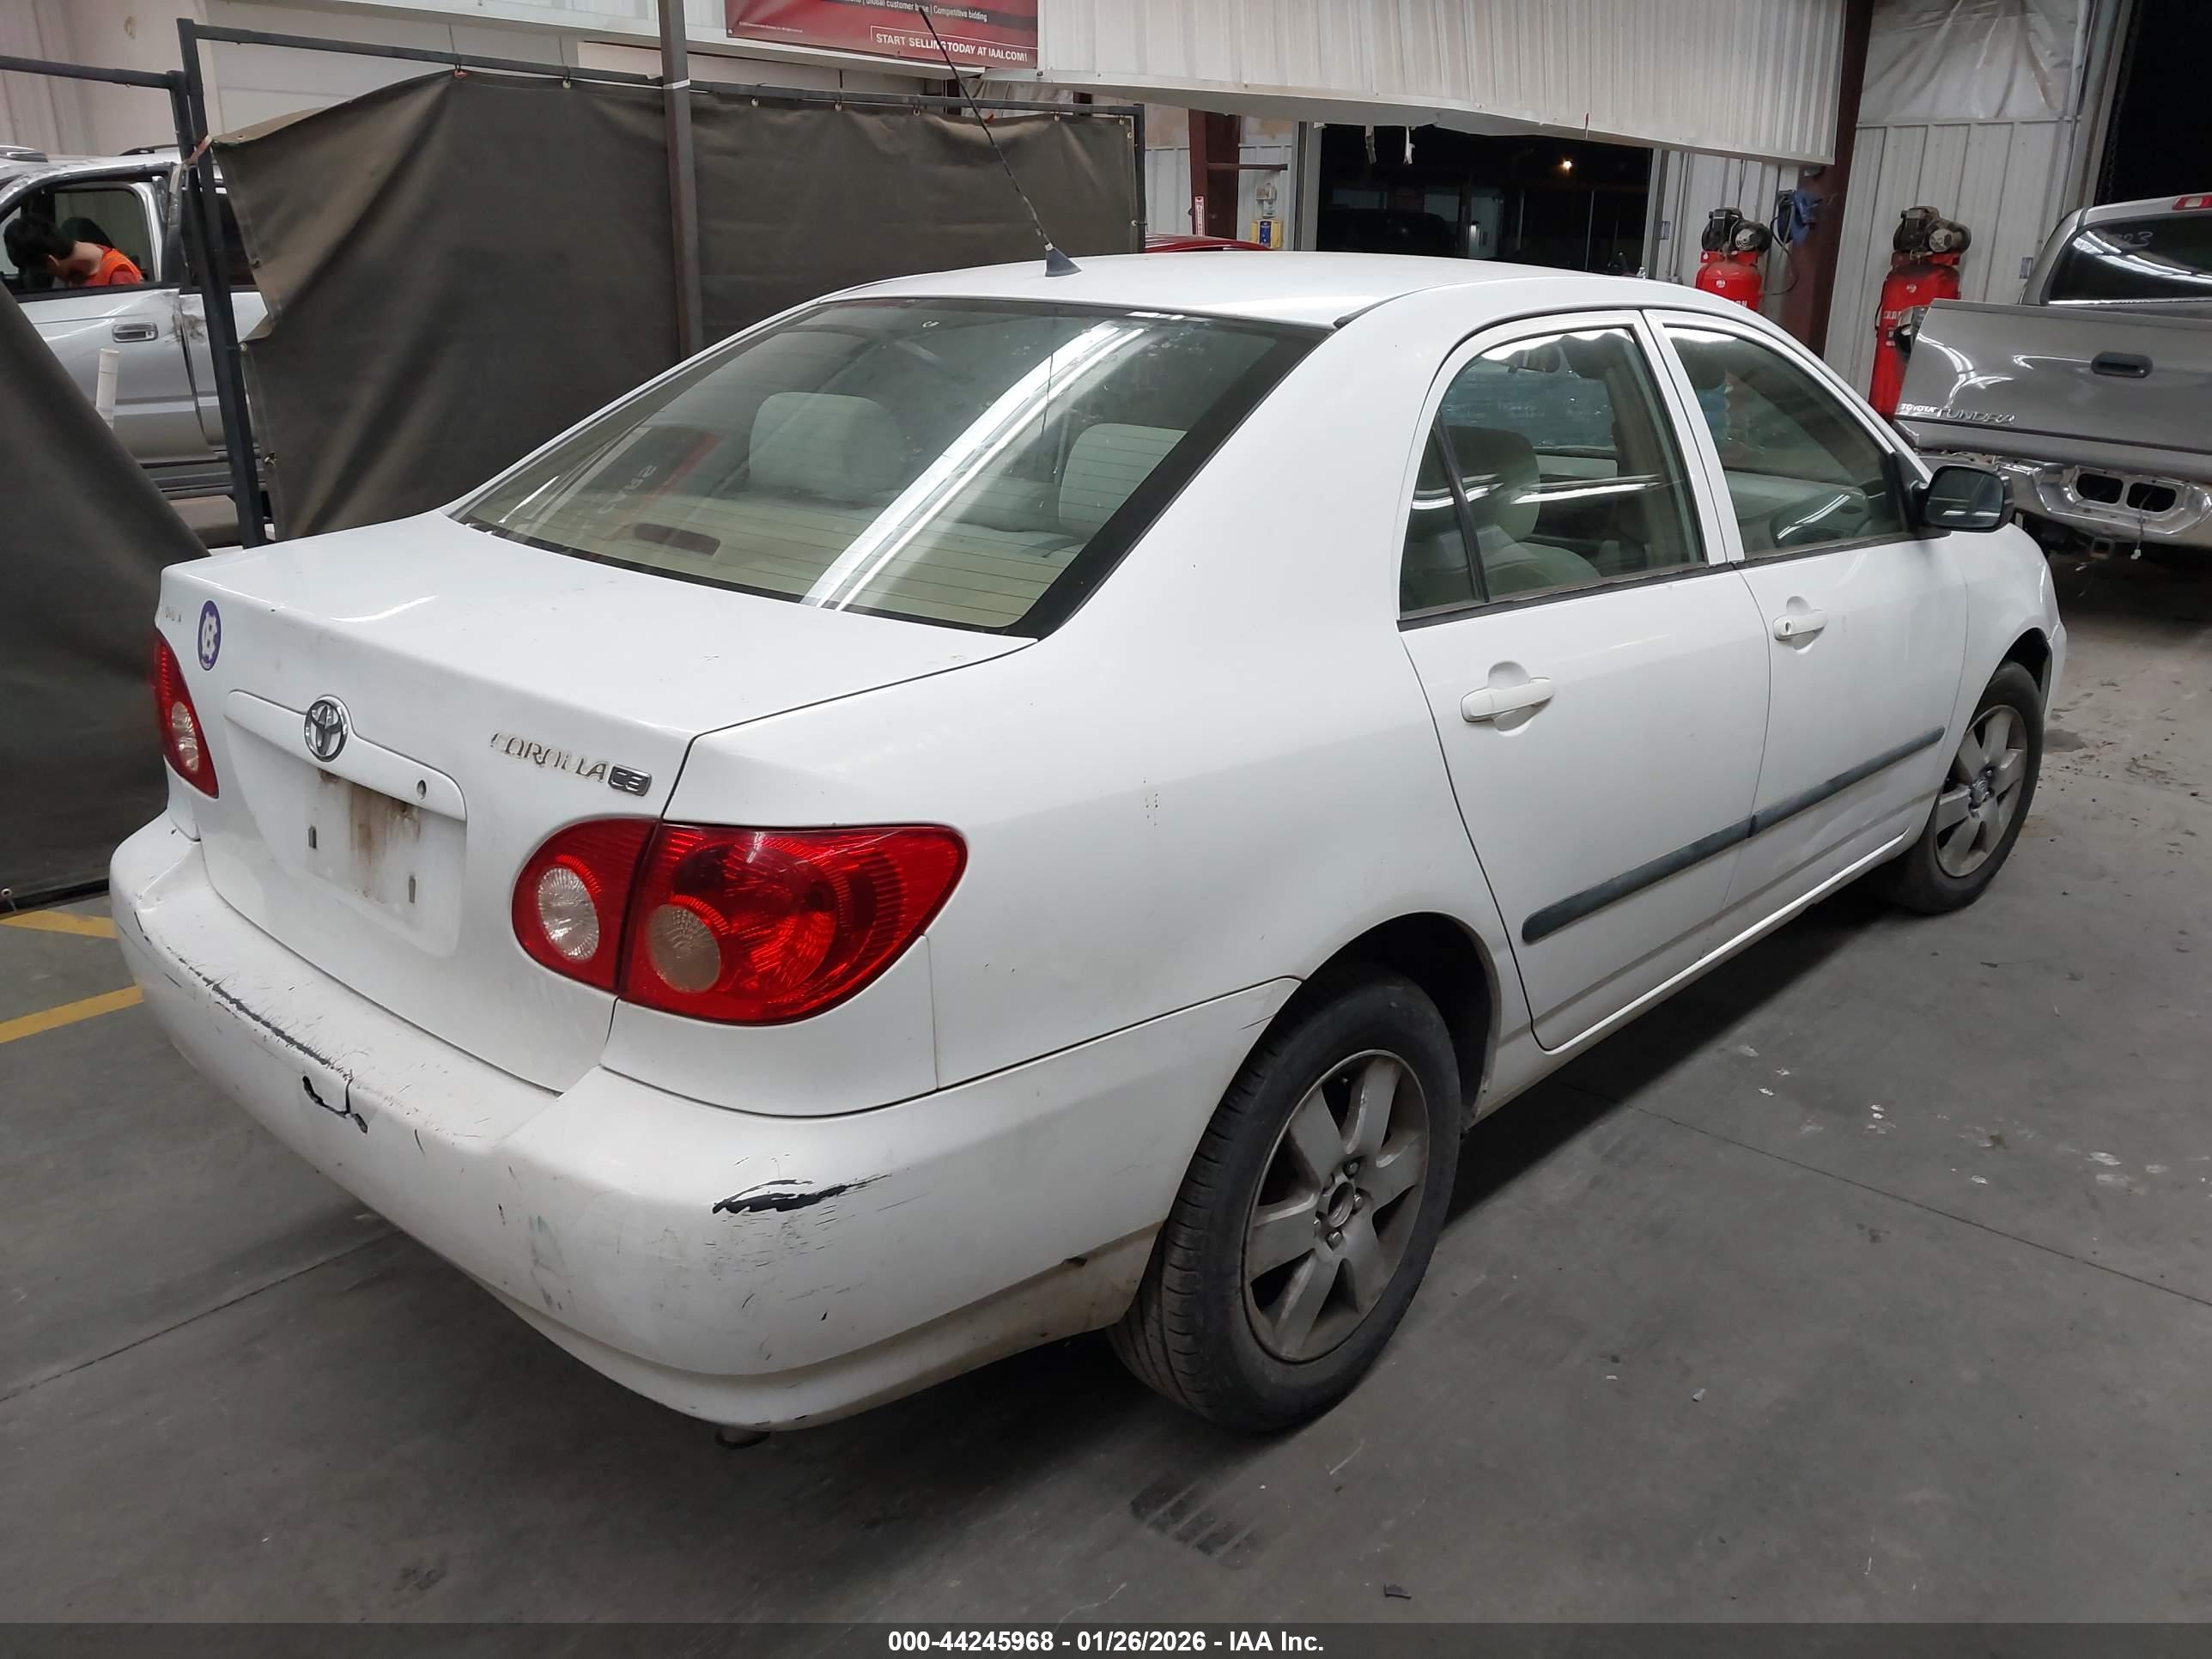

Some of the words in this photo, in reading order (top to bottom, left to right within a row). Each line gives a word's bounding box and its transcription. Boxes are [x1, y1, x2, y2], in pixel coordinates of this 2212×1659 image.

[886, 1, 914, 10] customer
[915, 3, 929, 13] bse
[933, 5, 968, 17] Competitive
[968, 9, 988, 22] bidding
[876, 33, 905, 46] START
[908, 37, 946, 50] SELLING
[946, 41, 975, 55] TODAY
[977, 46, 988, 57] AT
[1901, 403, 1938, 413] TOYOTA
[1937, 407, 2015, 425] TUNDRA
[489, 732, 609, 783] COROLLA
